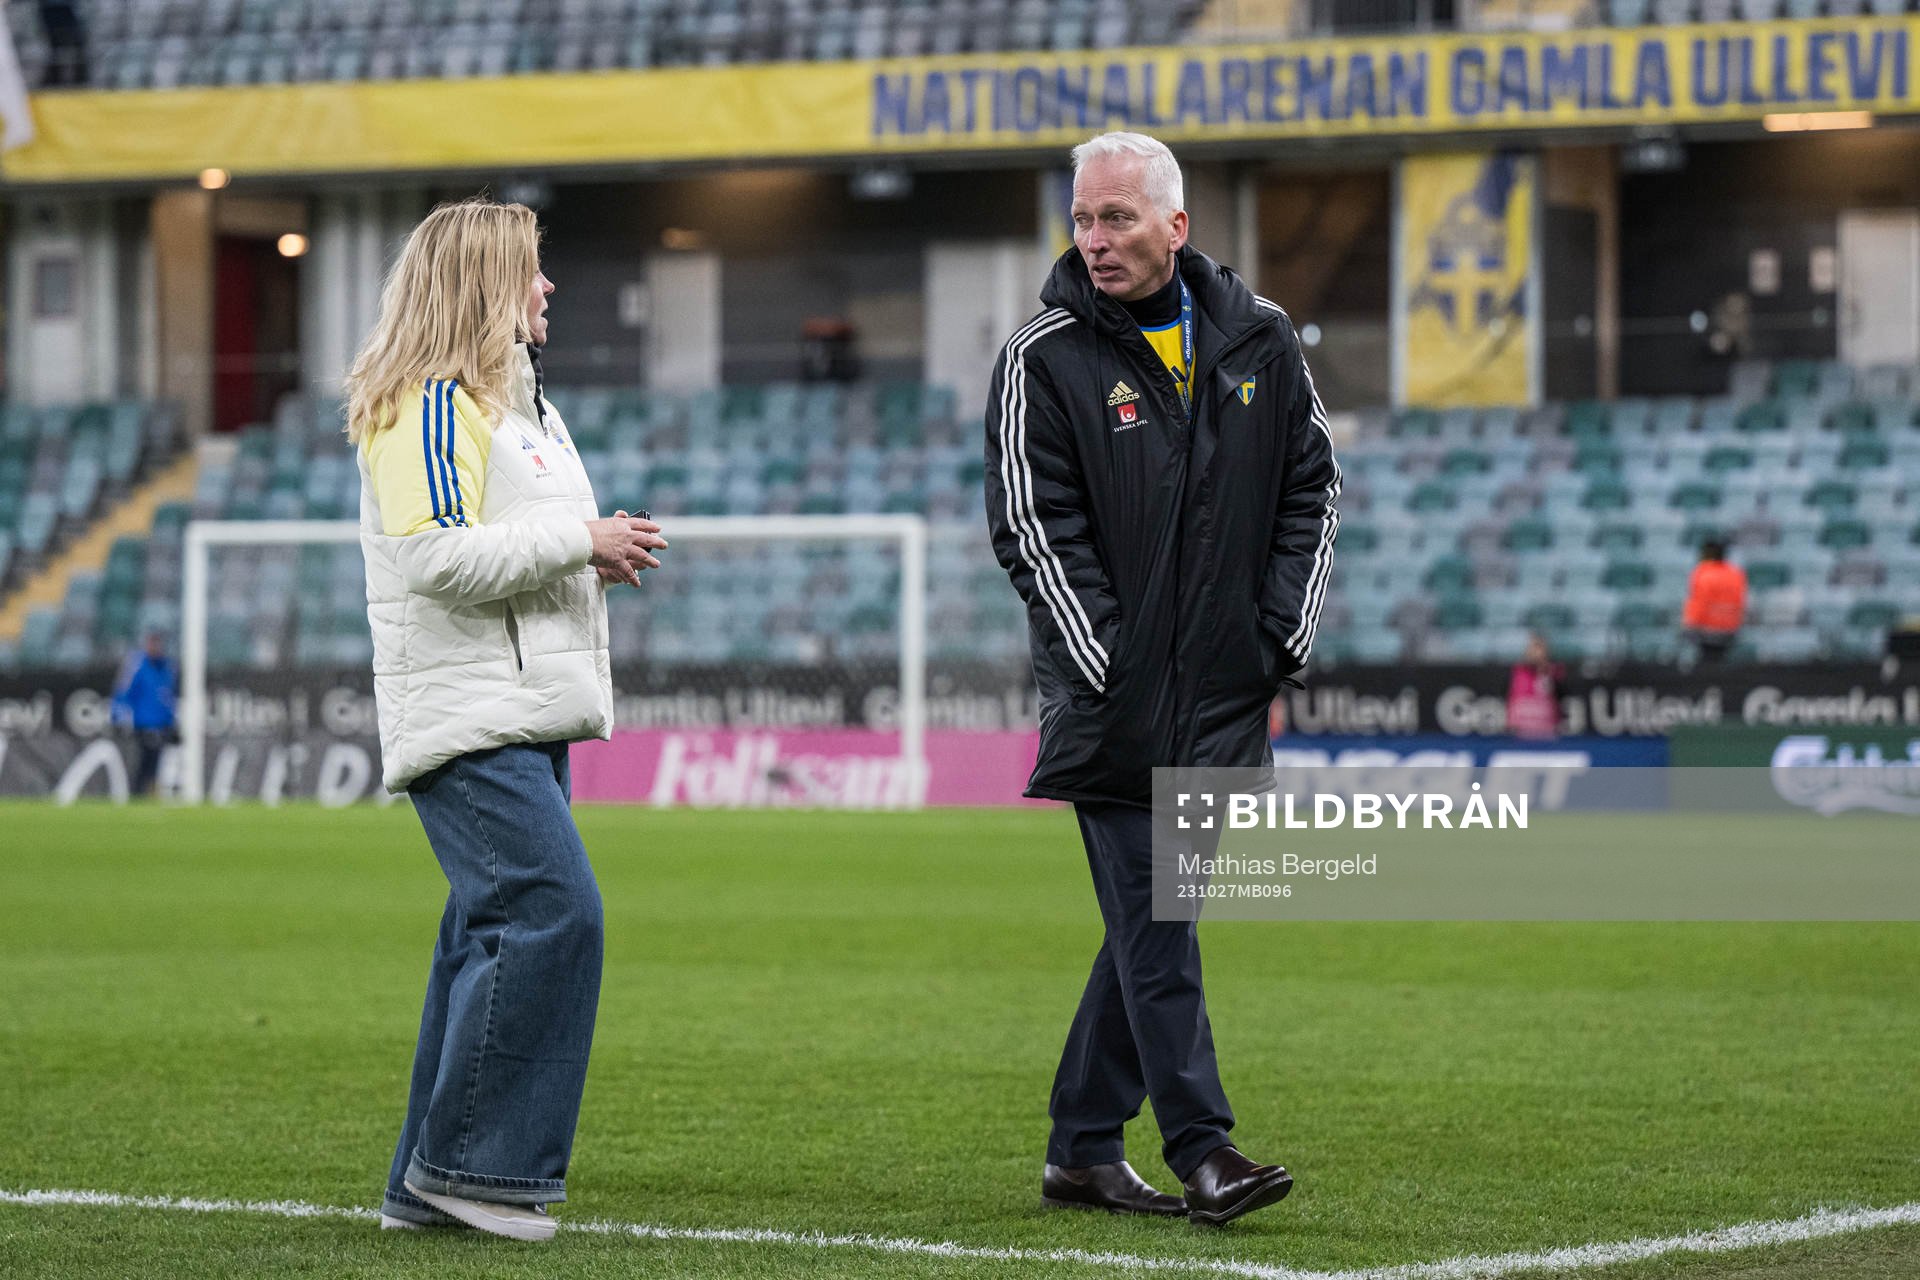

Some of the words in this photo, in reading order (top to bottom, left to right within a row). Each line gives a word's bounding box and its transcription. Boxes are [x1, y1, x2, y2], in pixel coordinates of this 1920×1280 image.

[1449, 40, 1673, 116] GAMLA
[1691, 30, 1909, 106] ULLEVI
[1107, 392, 1141, 406] adidas
[1113, 423, 1136, 433] SVENSKA
[1136, 419, 1149, 427] SPEL
[1292, 686, 1419, 736] Ullevi
[1590, 686, 1723, 736] Ullevi
[650, 734, 930, 809] Folksam
